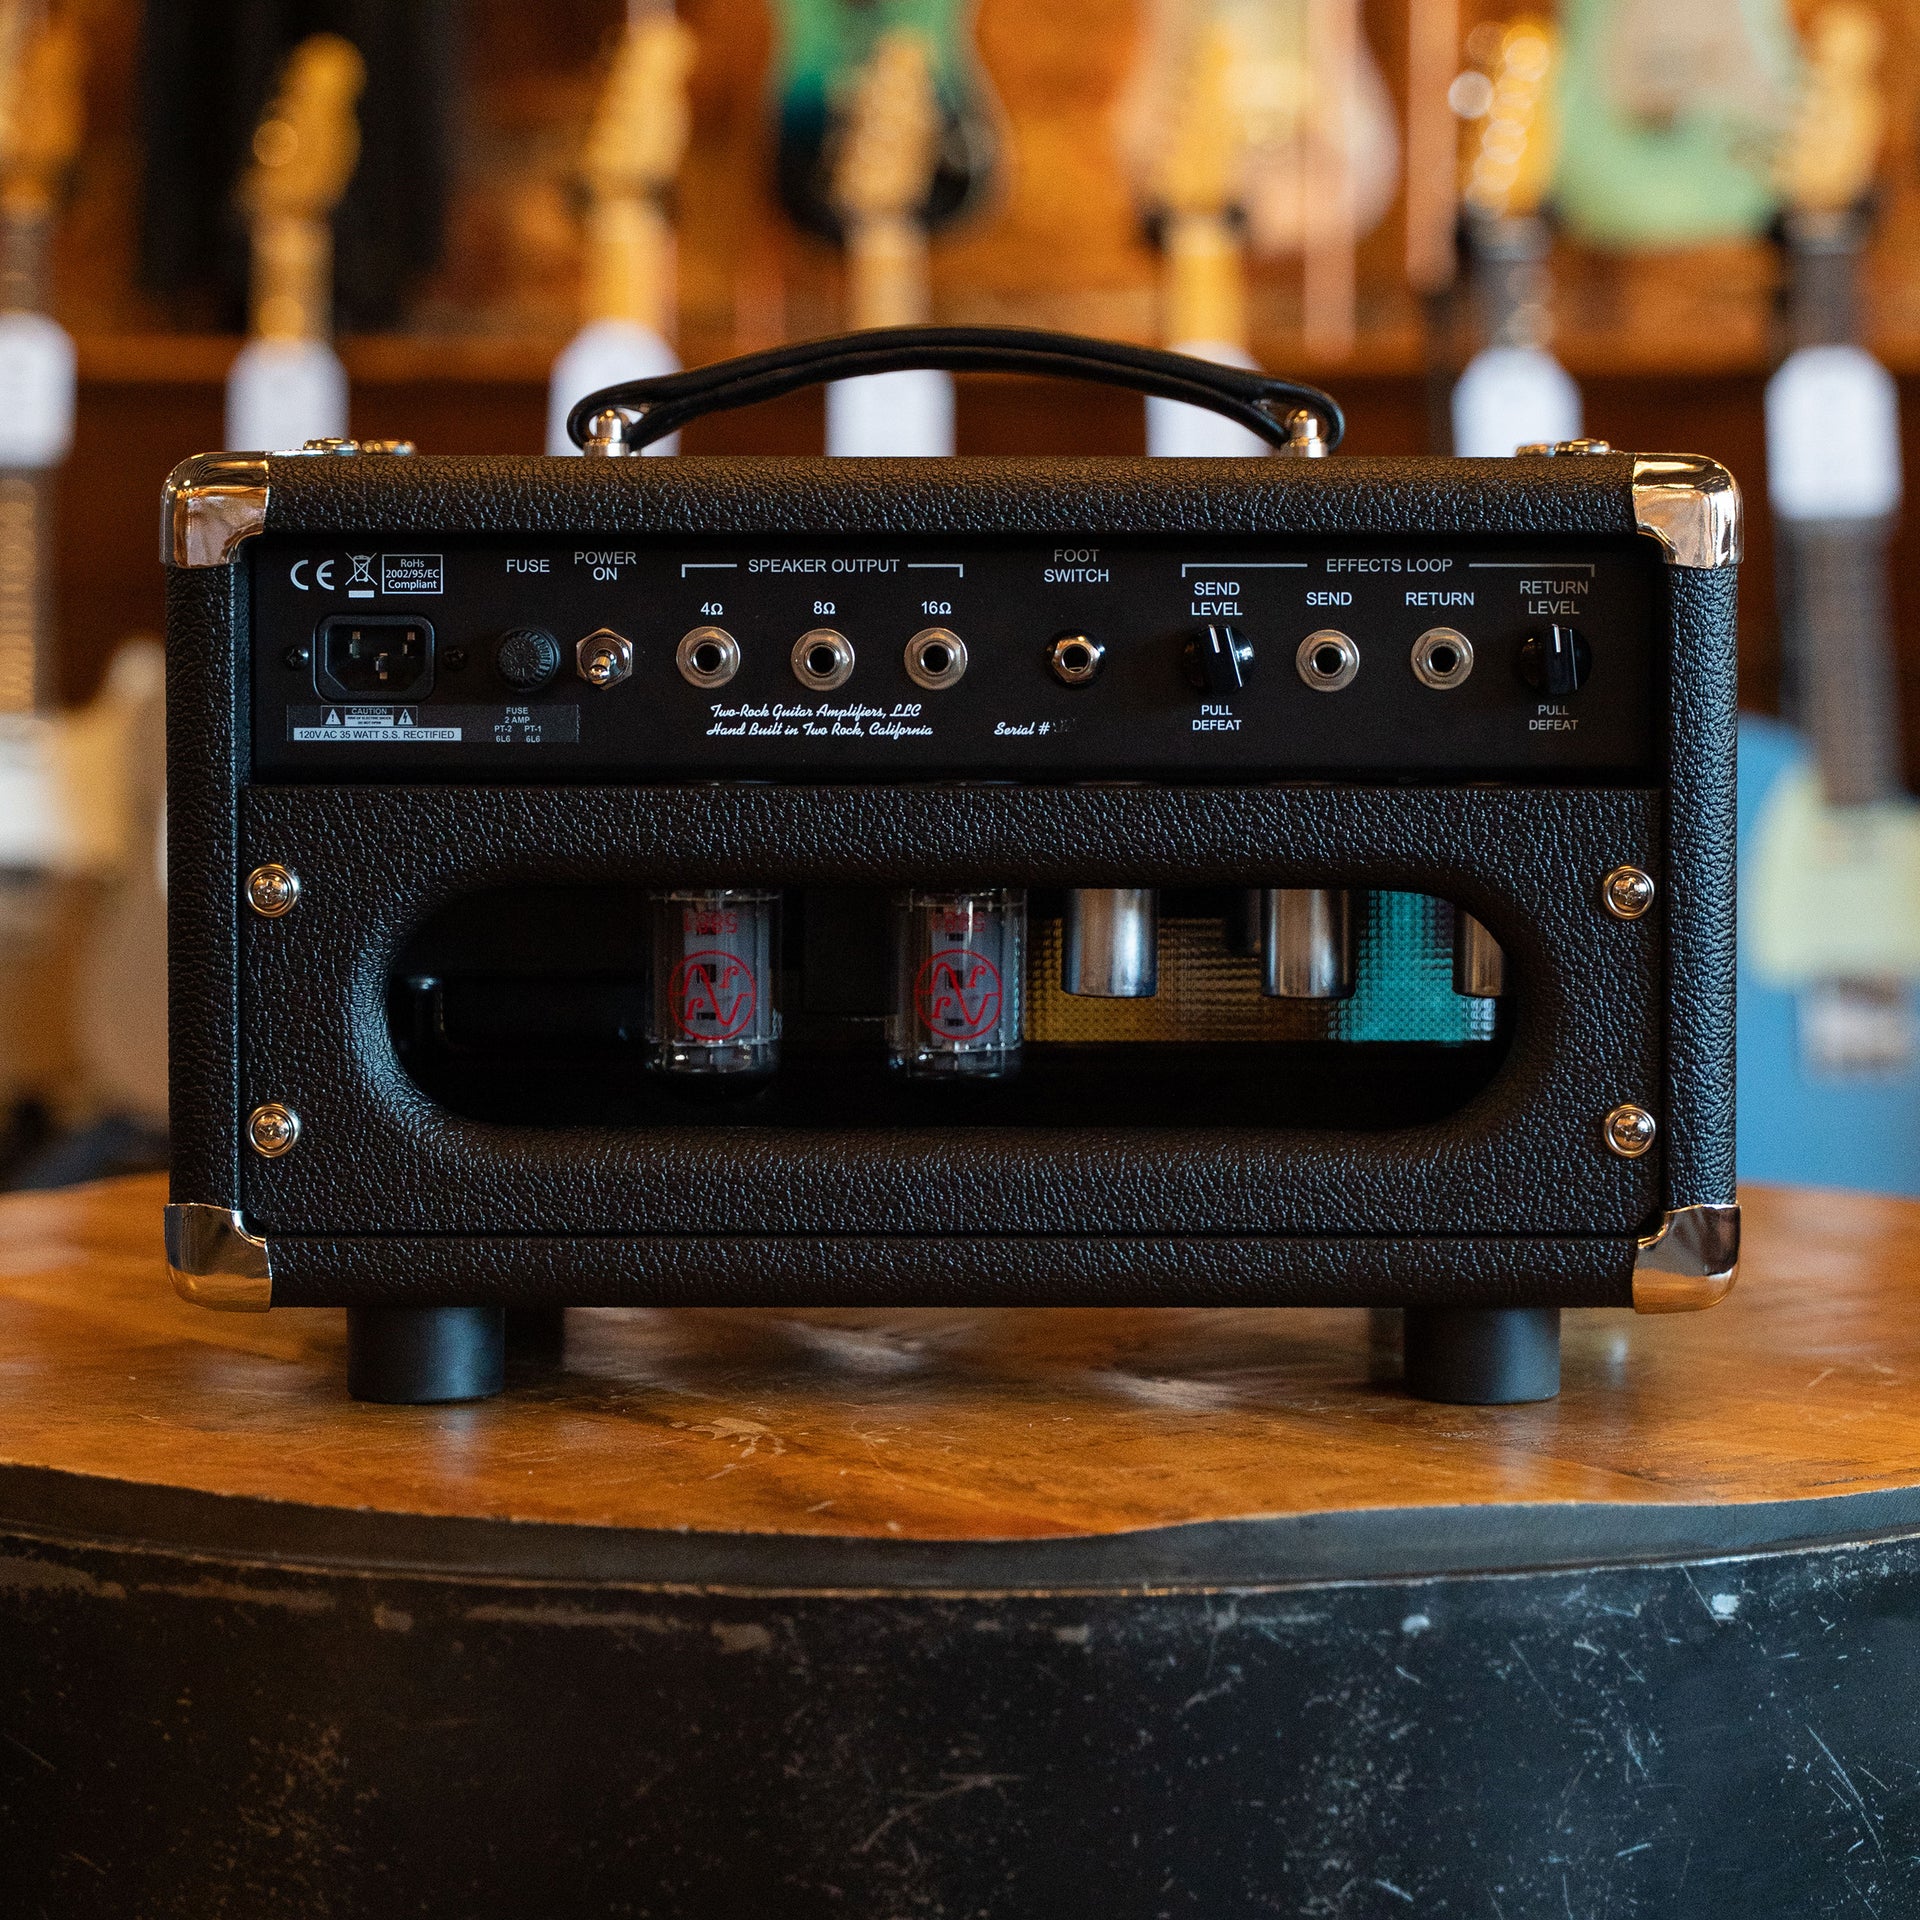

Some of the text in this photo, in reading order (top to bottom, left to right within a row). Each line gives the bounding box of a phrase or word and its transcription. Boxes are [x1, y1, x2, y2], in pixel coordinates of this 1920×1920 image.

[575, 552, 636, 564] POWER
[1054, 550, 1099, 562] FOOT
[400, 558, 425, 568] RoHs
[507, 560, 550, 572] FUSE
[749, 559, 900, 572] SPEAKER OUTPUT
[1327, 559, 1452, 572] EFFECTS LOOP
[291, 560, 334, 590] CE
[385, 569, 440, 579] 2002/95/EC
[593, 567, 617, 580] ON
[1044, 569, 1108, 582] SWITCH
[388, 579, 437, 591] Compliant
[1194, 582, 1240, 595] SEND
[1520, 581, 1588, 594] RETURN
[1307, 592, 1352, 605] SEND
[1406, 592, 1474, 605] RETURN
[1192, 602, 1242, 615] LEVEL
[1529, 601, 1579, 614] LEVEL
[352, 707, 387, 715] CAUTION
[506, 706, 529, 715] FUSE
[711, 704, 921, 720] Two-Rock Guitar Amplifiers, LLC
[1202, 705, 1232, 715] PULL
[1538, 705, 1568, 715] PULL
[504, 716, 531, 724] 2 AMP
[1193, 720, 1241, 730] DEFEAT
[1529, 720, 1578, 730] DEFEAT
[494, 725, 542, 733] PT-2 PT-1
[706, 722, 933, 739] Hand Built in Two Rock, California
[994, 722, 1035, 735] Serial
[299, 730, 321, 740] 120V
[323, 730, 337, 740] AC
[339, 730, 351, 740] 35
[353, 730, 380, 740] WATT
[403, 730, 455, 740] RECTIFIED
[495, 735, 541, 743] 6L6 6L6
